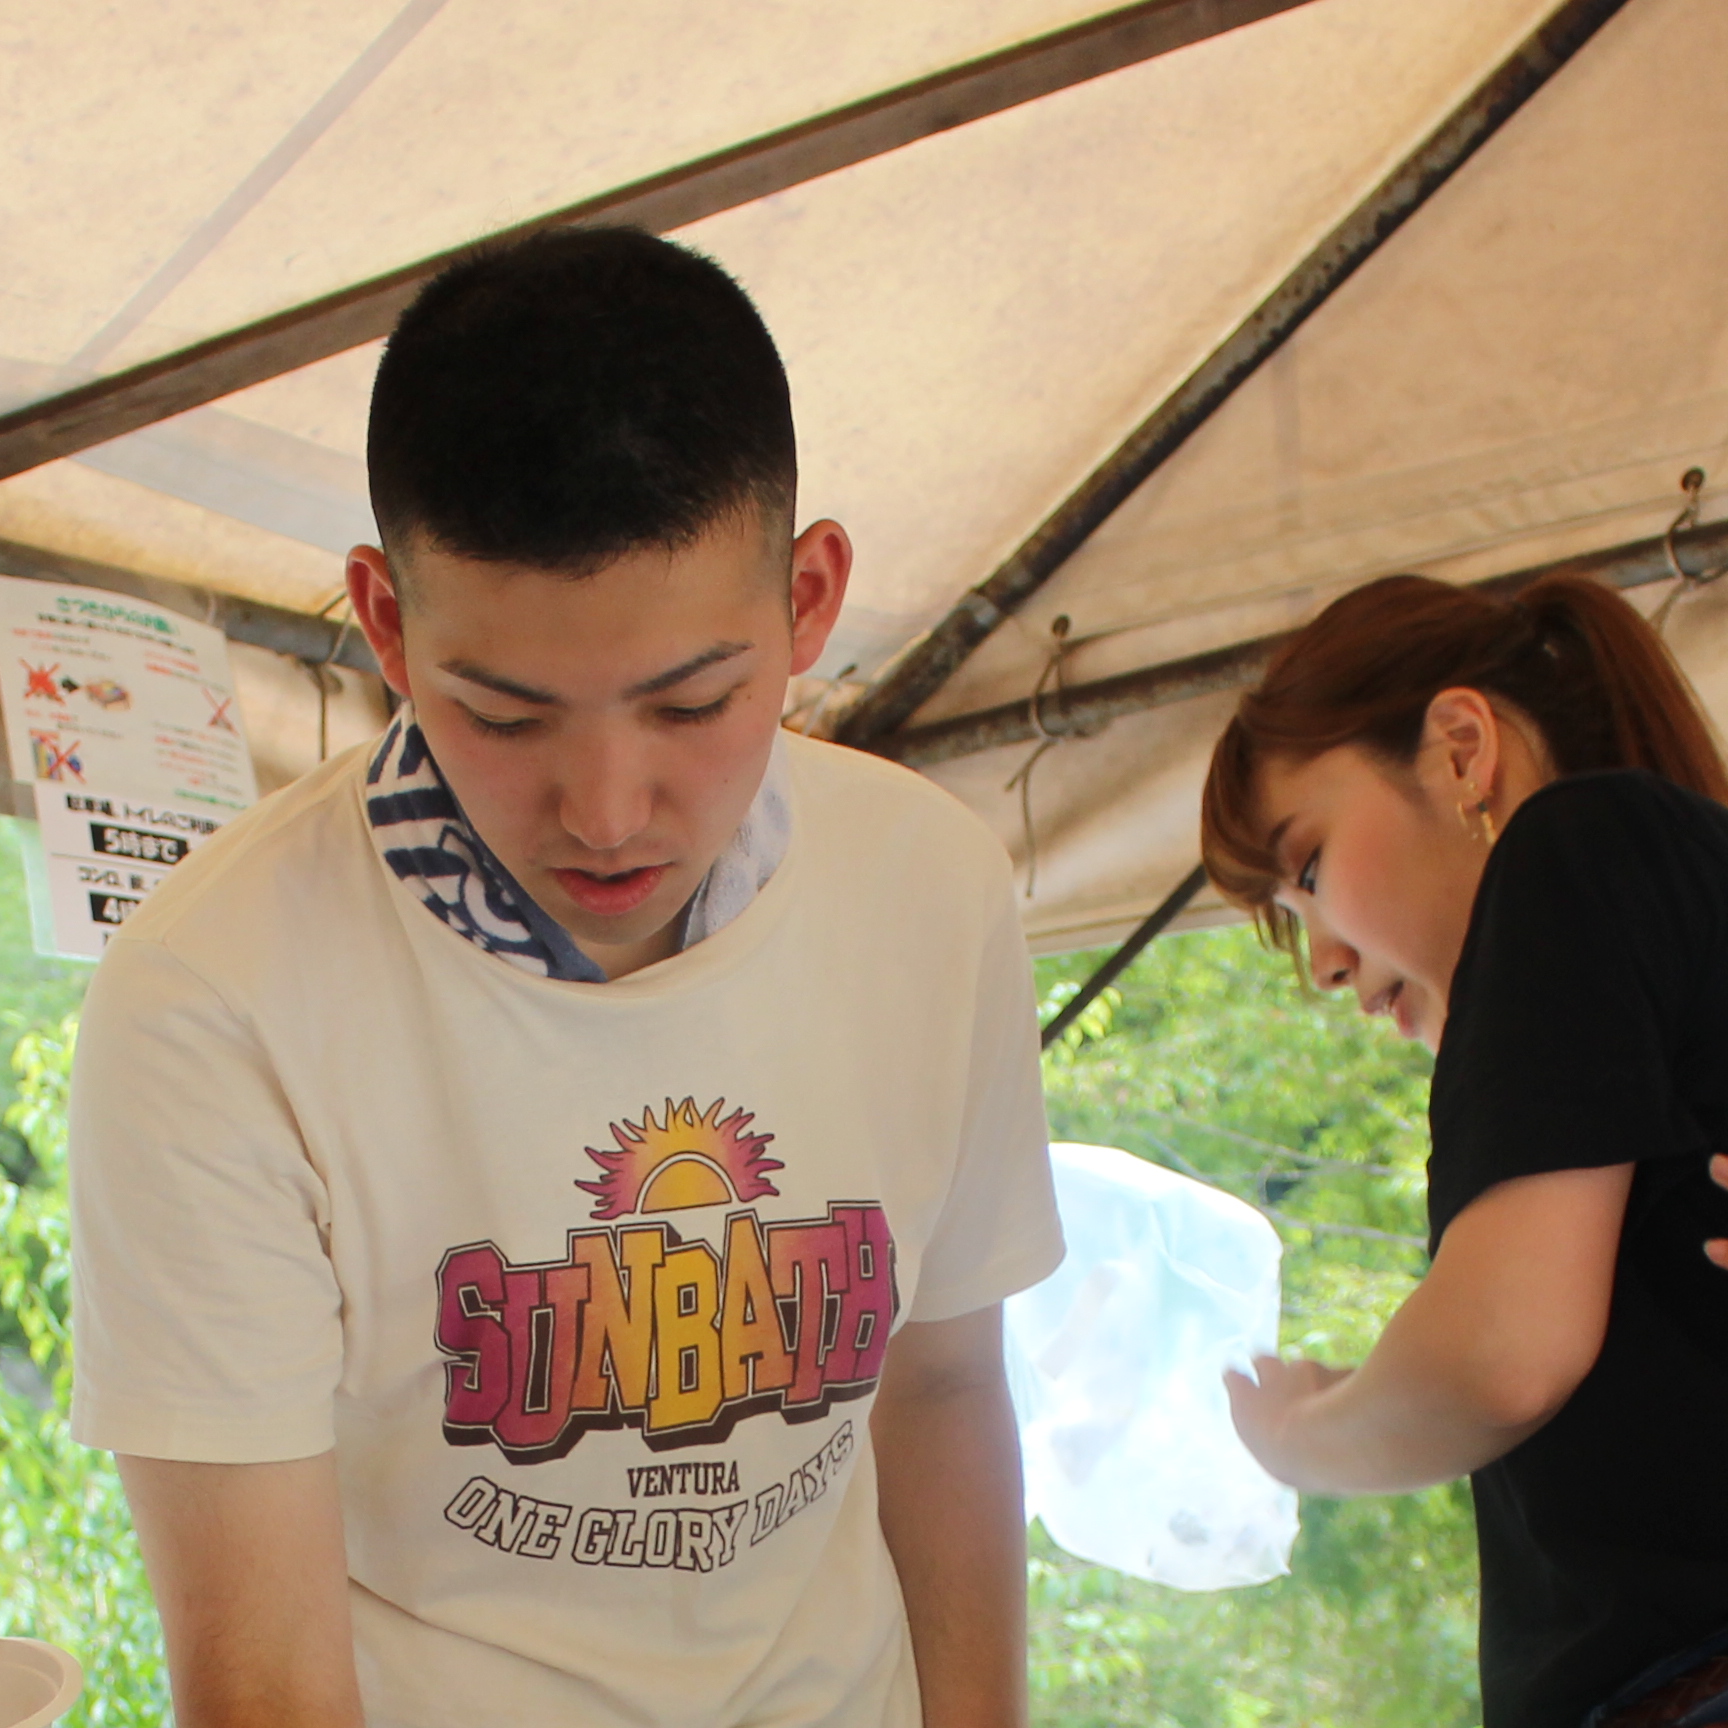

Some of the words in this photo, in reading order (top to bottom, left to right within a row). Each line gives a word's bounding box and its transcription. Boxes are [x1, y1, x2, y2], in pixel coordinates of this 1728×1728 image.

[102, 826, 180, 864] 5時まで
[434, 1200, 901, 1466] SUNBATH
[444, 1476, 572, 1560] ONE
[572, 1499, 749, 1573] GLORY
[750, 1420, 855, 1546] DAYS
[627, 1460, 741, 1499] VENTURA
